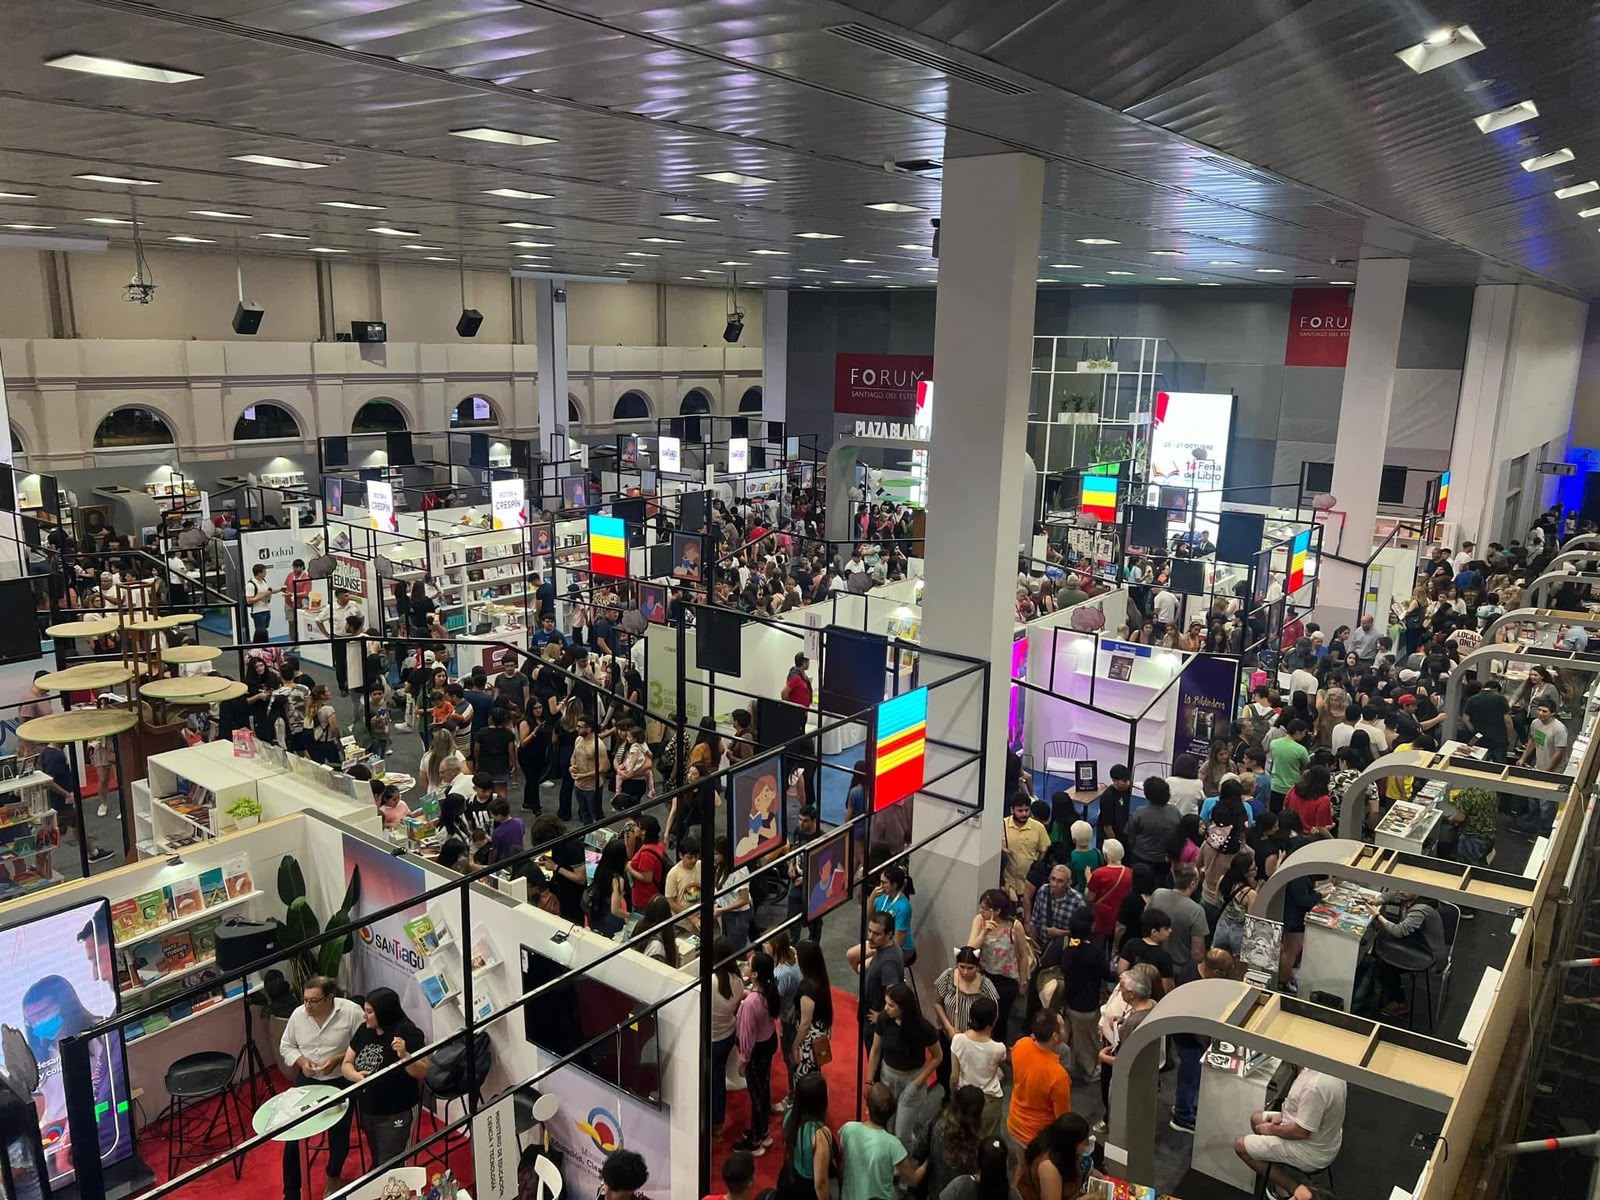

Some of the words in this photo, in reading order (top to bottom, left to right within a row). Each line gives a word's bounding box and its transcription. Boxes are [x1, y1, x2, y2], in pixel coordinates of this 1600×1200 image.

[1300, 316, 1348, 328] FORU
[851, 368, 924, 387] FORUM
[851, 391, 884, 399] SANTIAGO
[899, 392, 917, 400] ESTE
[855, 420, 888, 439] PLAZA
[1185, 461, 1197, 471] 14
[1197, 472, 1222, 481] Libro
[334, 574, 361, 591] EDUNSE
[1457, 631, 1481, 642] LOCALS
[1460, 638, 1477, 648] ONLY
[650, 681, 663, 709] 3
[497, 1147, 502, 1157] DE
[489, 1148, 497, 1191] TECNOLOGÍA
